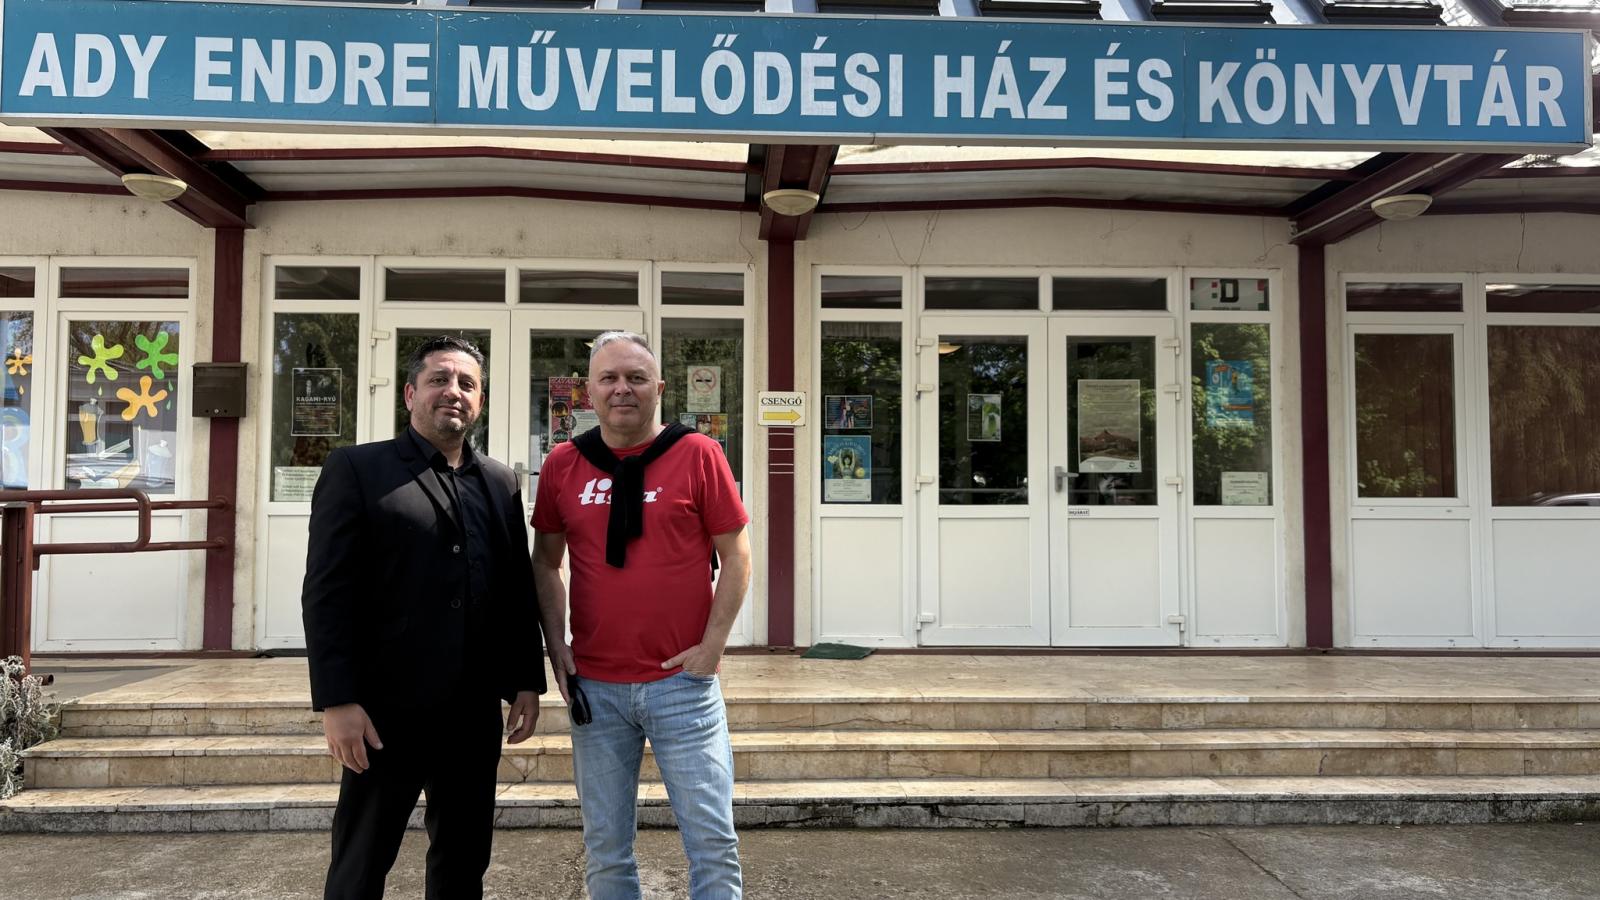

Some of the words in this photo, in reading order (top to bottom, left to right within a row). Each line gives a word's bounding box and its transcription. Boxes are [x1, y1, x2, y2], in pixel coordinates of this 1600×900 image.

[18, 32, 167, 100] ADY
[193, 36, 430, 108] ENDRE
[458, 30, 903, 118] MŰVELŐDÉSI
[933, 40, 1069, 120] HÁZ
[1094, 42, 1174, 122] ÉS
[1199, 48, 1567, 127] KÖNYVTÁR
